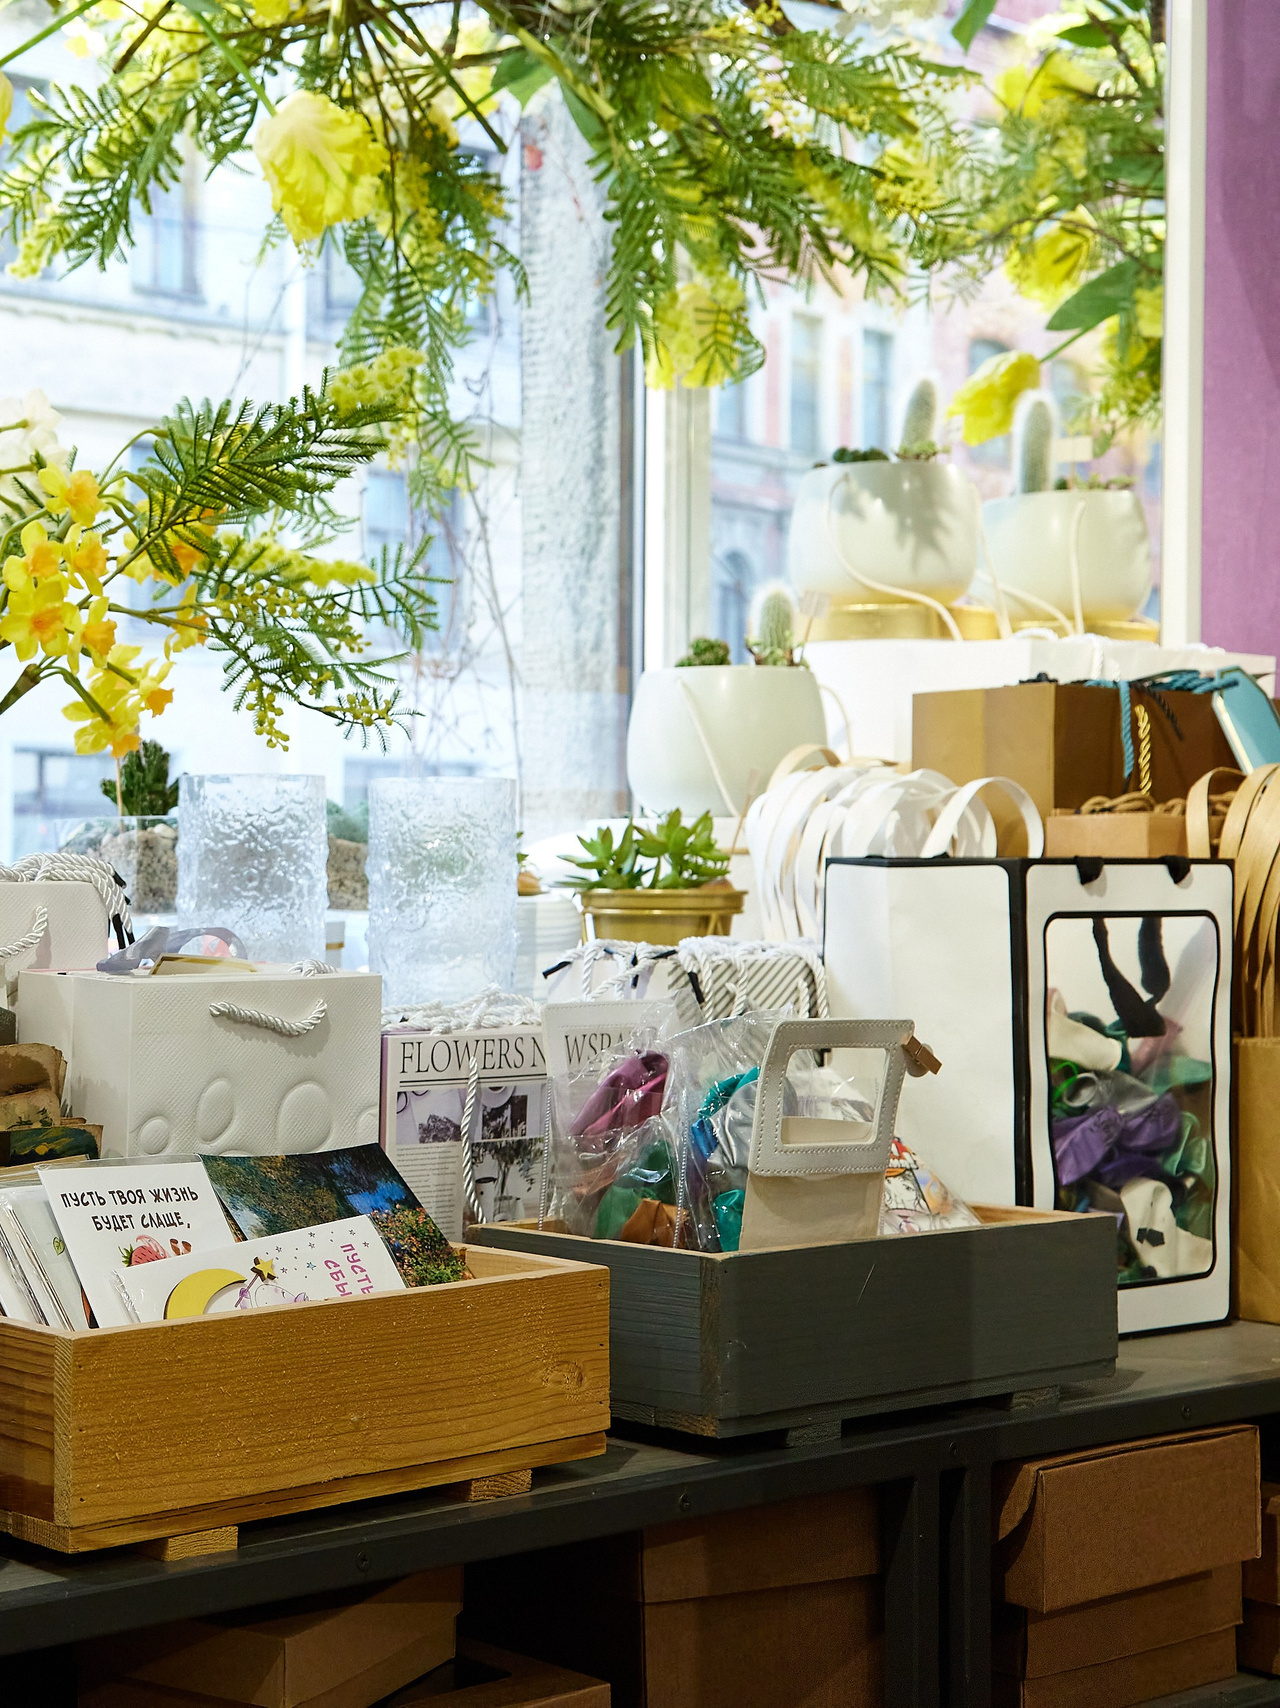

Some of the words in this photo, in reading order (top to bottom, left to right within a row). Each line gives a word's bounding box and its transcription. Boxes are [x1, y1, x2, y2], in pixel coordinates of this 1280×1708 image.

[399, 1036, 525, 1074] FLOWERS
[60, 1190, 107, 1208] ПУСТЬ
[108, 1188, 147, 1206] ТВОЯ
[148, 1186, 199, 1204] ЖИЗНЬ
[91, 1214, 135, 1232] БУДЕТ
[140, 1211, 191, 1229] СЛАЩЕ,
[340, 1243, 374, 1295] ПУСТЬ
